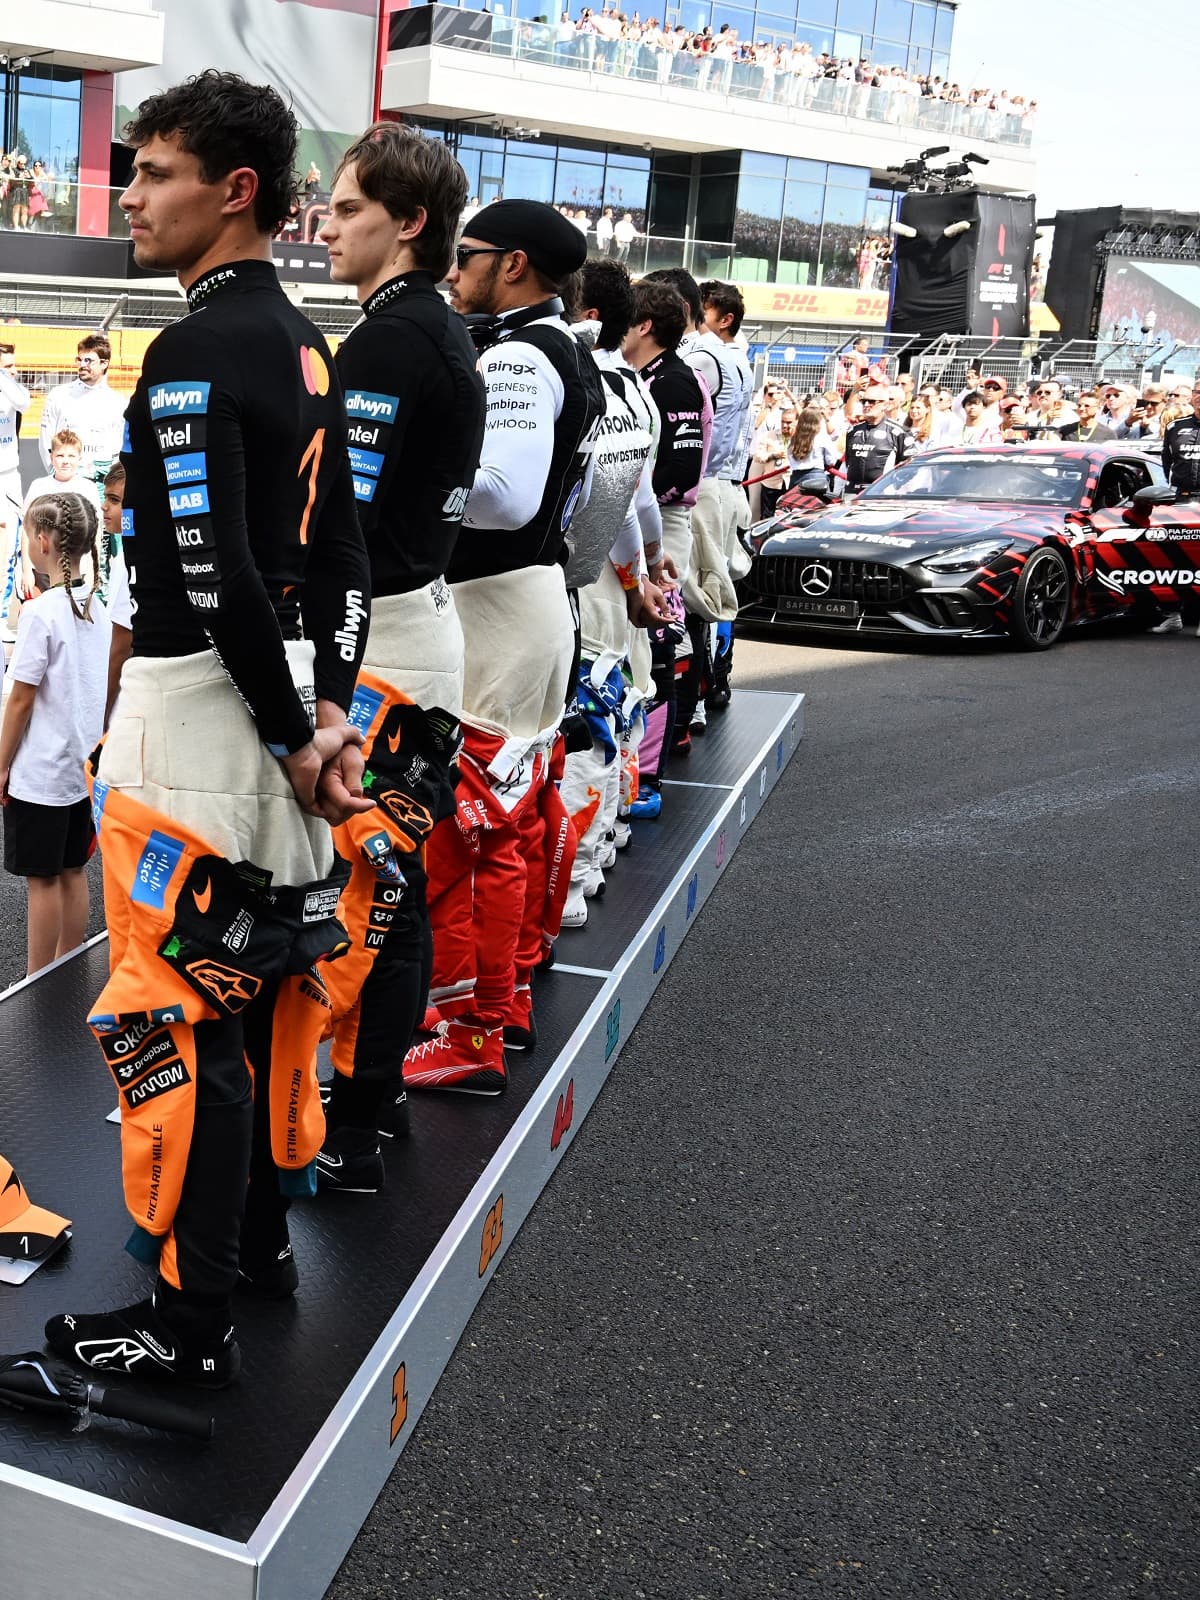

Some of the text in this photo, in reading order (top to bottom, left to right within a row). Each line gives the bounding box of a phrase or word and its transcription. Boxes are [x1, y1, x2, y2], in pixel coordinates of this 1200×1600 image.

[772, 292, 819, 313] DHL
[854, 297, 888, 317] DH
[151, 388, 202, 411] allwyn
[491, 382, 538, 395] GENESYS
[346, 394, 393, 417] allwyn
[485, 400, 531, 414] ambipar
[158, 423, 191, 449] intel
[348, 425, 380, 445] ntel
[485, 419, 537, 431] WHOOP
[852, 443, 875, 453] SAFETY
[855, 450, 869, 458] CAR
[175, 525, 204, 547] kta
[793, 530, 917, 549] CROWDSTRIKE
[785, 600, 847, 614] SAFETY CAR
[335, 589, 363, 662] allwyn
[346, 701, 362, 727] cisc
[547, 816, 569, 897] RICHARD MILLE
[140, 852, 157, 884] cisco
[383, 887, 404, 903] ok
[113, 1021, 155, 1054] okta
[133, 1040, 172, 1070] Dropbox
[286, 1068, 303, 1162] RICHARD MILLE
[146, 1123, 163, 1223] RICHARD MILLE
[19, 1235, 29, 1255] 1
[389, 1361, 408, 1447] 1
